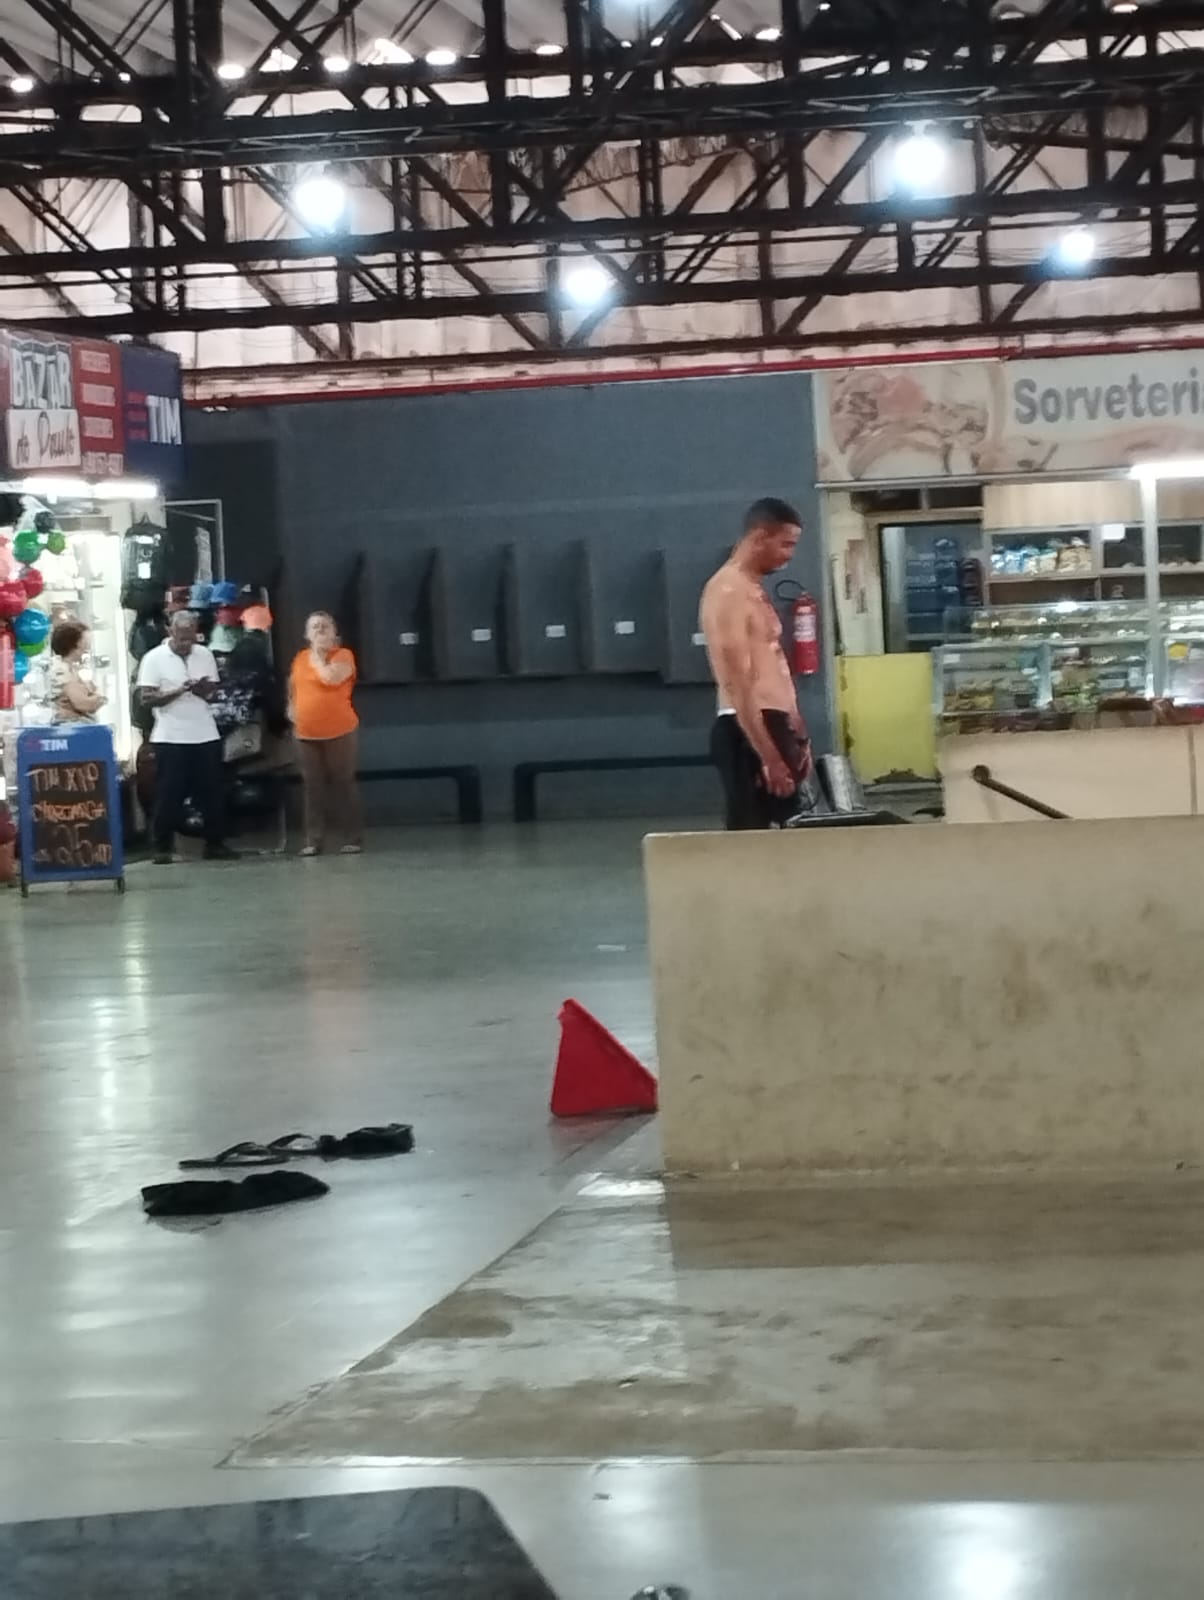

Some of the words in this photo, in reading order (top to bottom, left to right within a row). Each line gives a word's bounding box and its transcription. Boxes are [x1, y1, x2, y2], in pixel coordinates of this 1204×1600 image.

[11, 347, 72, 409] BAZAR
[1013, 366, 1204, 424] Sorveteri
[147, 395, 182, 445] TIM
[39, 739, 69, 751] TIM
